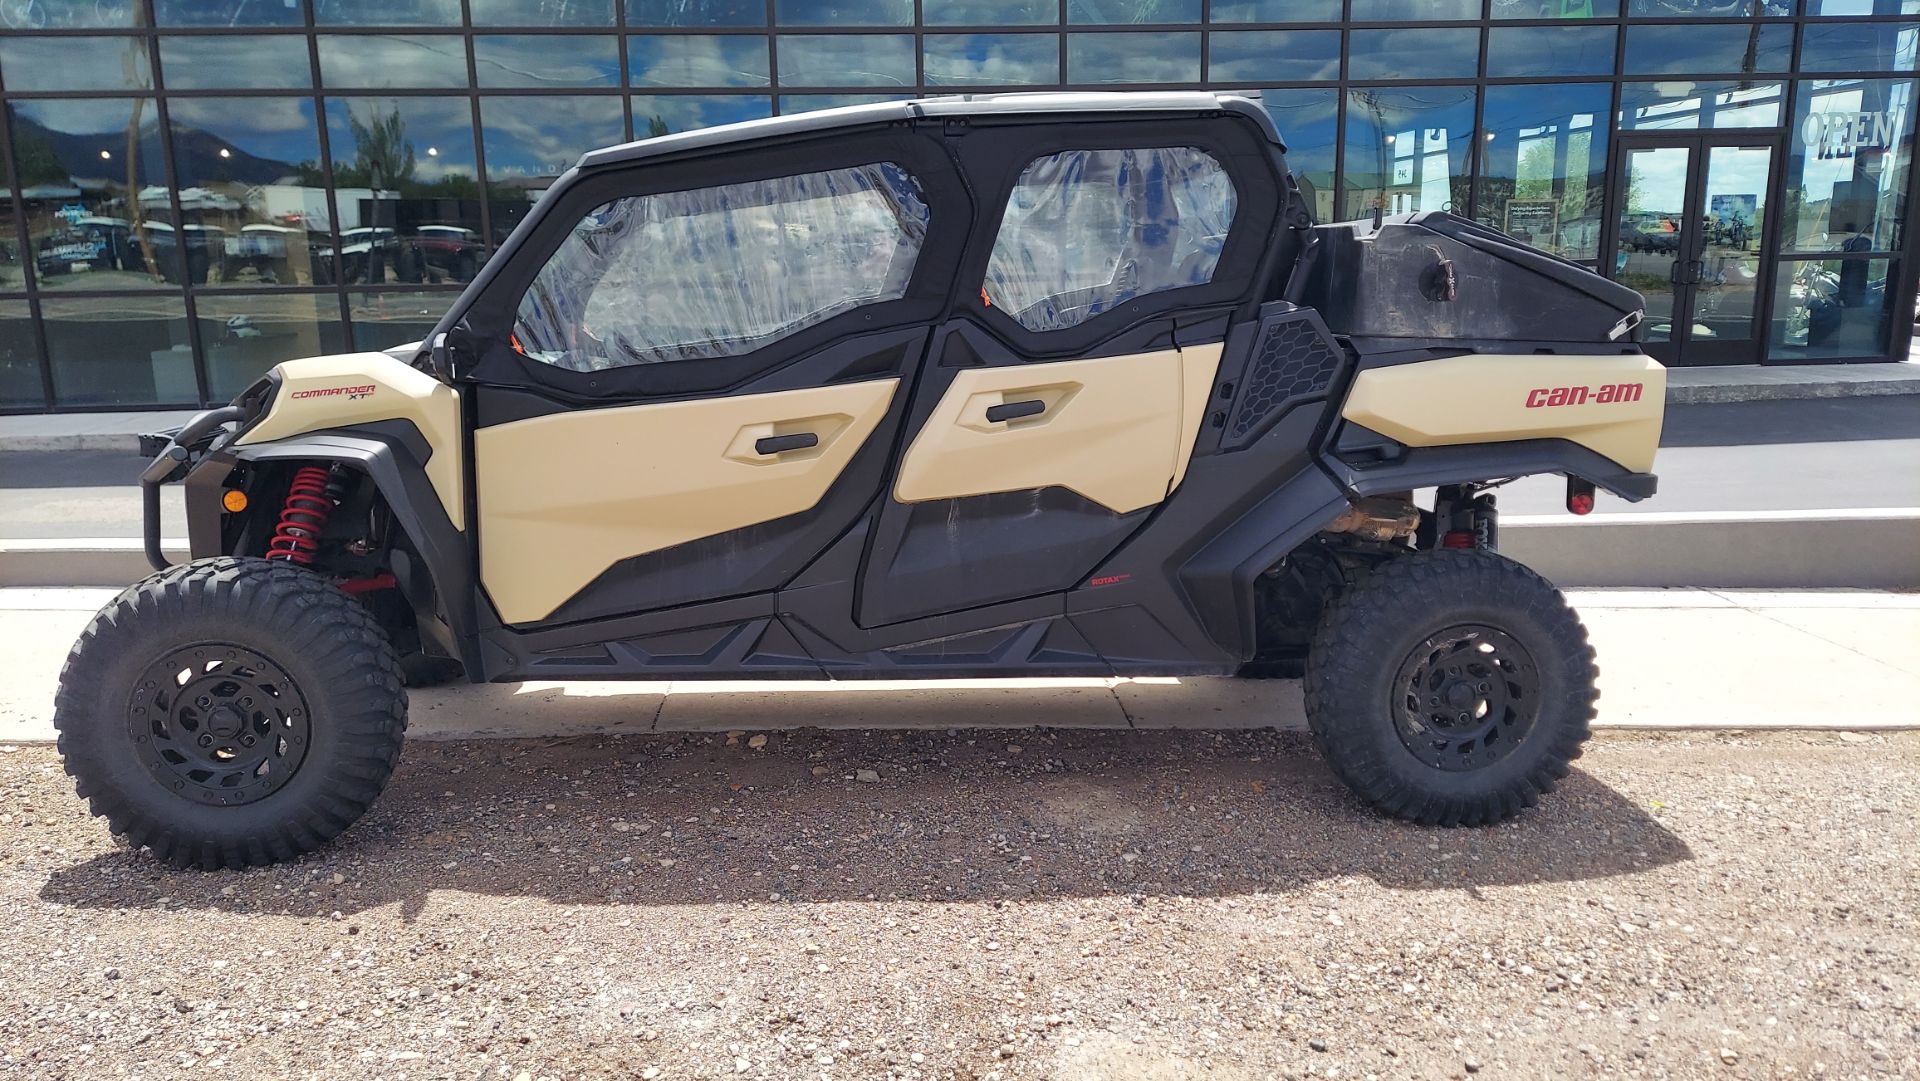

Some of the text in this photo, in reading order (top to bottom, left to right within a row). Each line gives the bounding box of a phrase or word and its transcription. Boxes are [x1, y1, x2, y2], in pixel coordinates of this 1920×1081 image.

[1801, 111, 1895, 147] OPEN
[291, 384, 376, 399] COMMANDER
[1525, 382, 1643, 408] can-am
[1091, 575, 1120, 585] ROTAX
